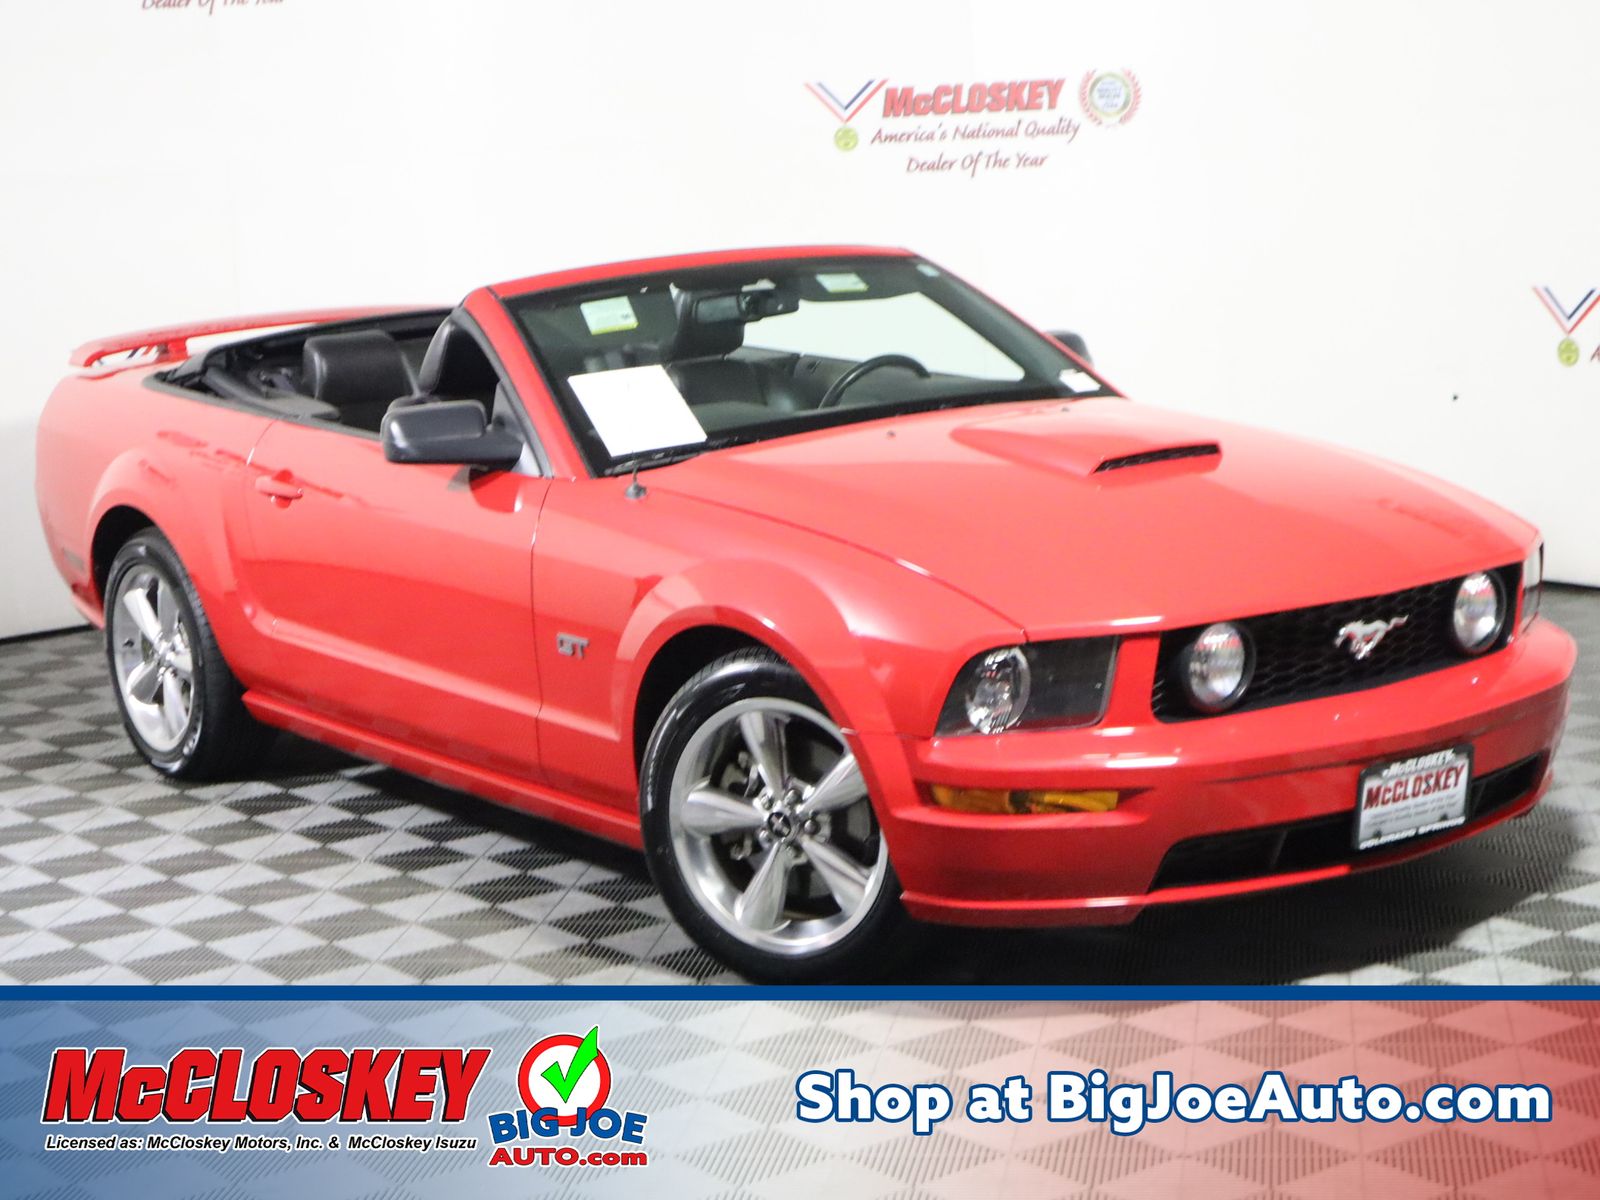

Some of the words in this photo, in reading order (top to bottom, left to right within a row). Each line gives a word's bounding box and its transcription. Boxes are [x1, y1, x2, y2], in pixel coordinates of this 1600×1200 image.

[882, 78, 1065, 118] McCLOSKEY
[870, 122, 947, 145] America's
[952, 119, 1021, 141] National
[1025, 115, 1081, 144] Quality
[906, 152, 958, 173] Dealer
[961, 151, 983, 178] Of
[984, 150, 1011, 169] The
[1015, 152, 1049, 169] Year
[1363, 764, 1465, 810] McCLOSKEY
